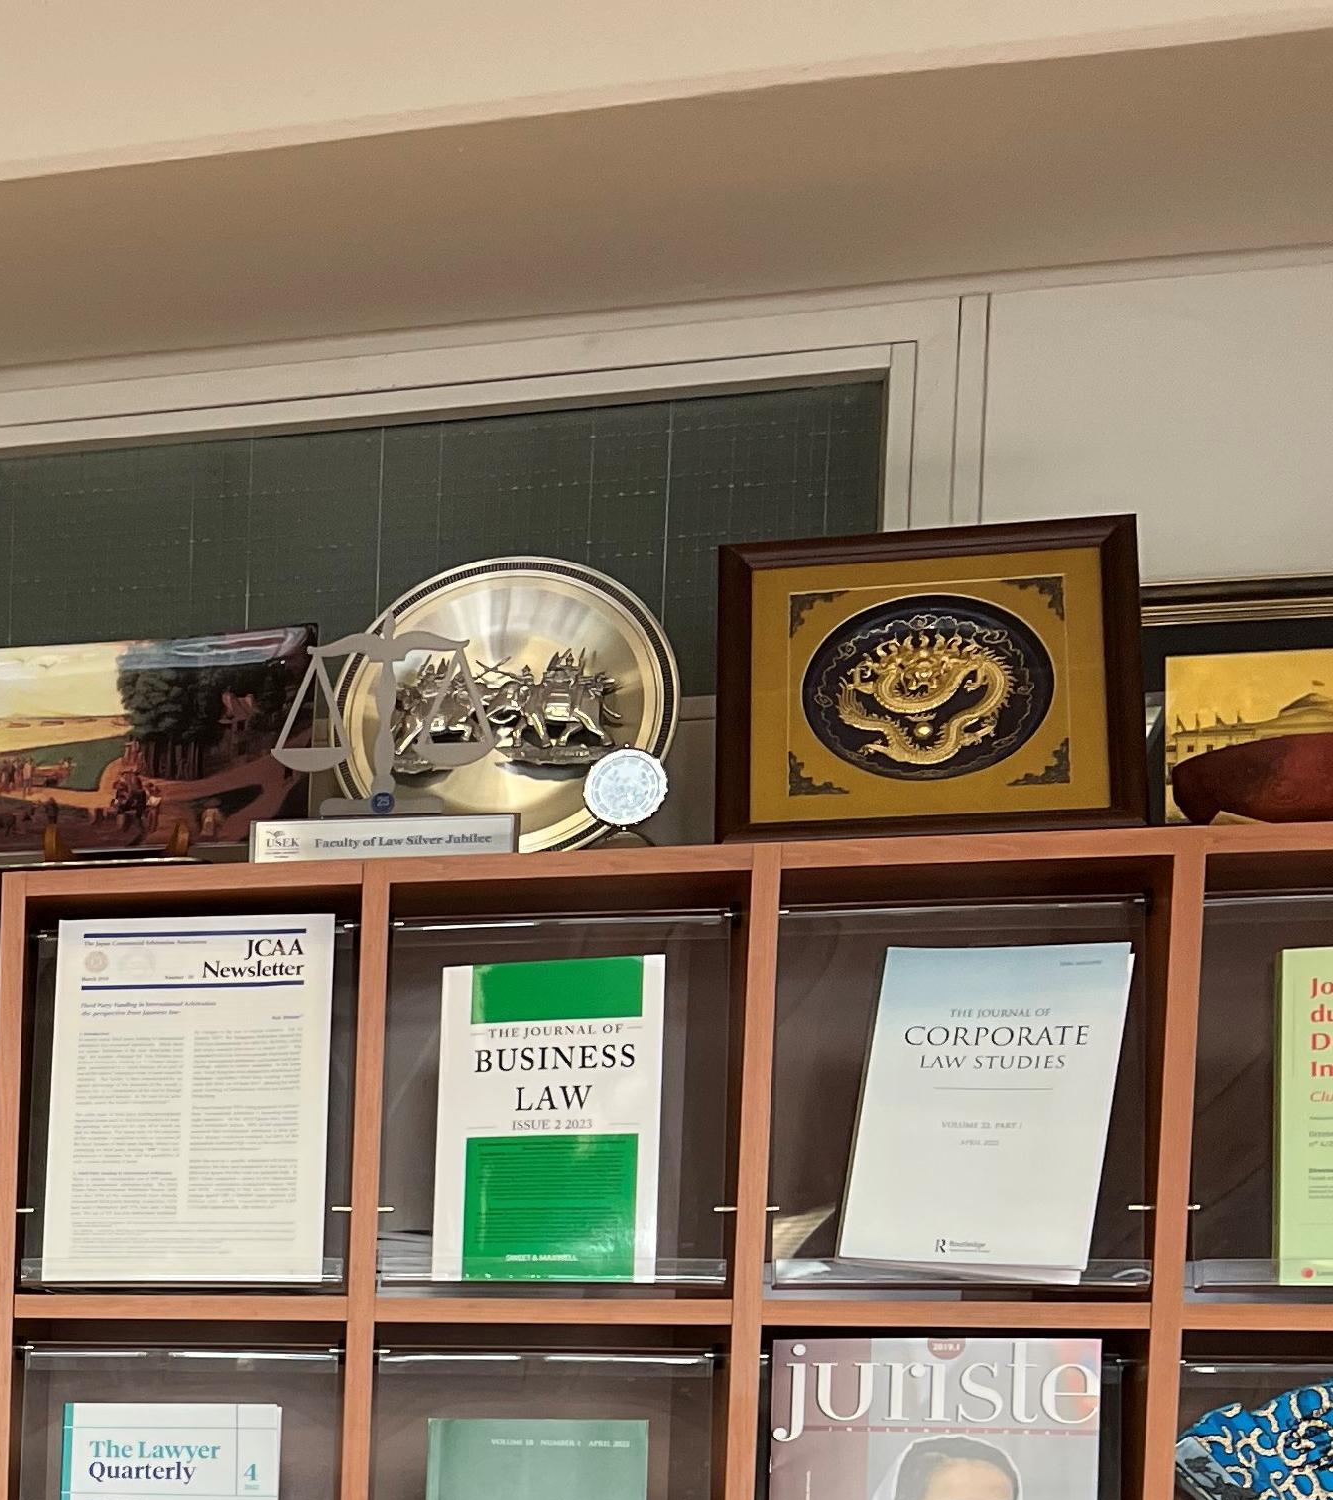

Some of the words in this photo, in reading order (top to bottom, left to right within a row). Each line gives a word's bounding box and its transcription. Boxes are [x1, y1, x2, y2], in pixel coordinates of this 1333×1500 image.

[315, 837, 359, 849] Faculty
[363, 837, 376, 847] of
[379, 836, 405, 847] Law
[406, 835, 444, 846] Silver
[445, 833, 493, 845] Jubilee
[244, 938, 304, 961] JCAA
[202, 960, 305, 979] Newsletter
[950, 1008, 974, 1018] THE
[977, 1007, 1032, 1019] JOURNAL
[1036, 1007, 1052, 1017] OF
[488, 1027, 519, 1039] THE
[523, 1024, 598, 1040] JOURNAL
[602, 1023, 625, 1035] OF
[904, 1023, 1091, 1047] CORPORATE
[474, 1043, 636, 1073] BUSINESS
[919, 1055, 967, 1069] LAW
[973, 1054, 1067, 1070] STUDIES
[515, 1084, 593, 1112] LAW
[512, 1119, 551, 1131] ISSUE
[554, 1119, 562, 1130] 2
[565, 1118, 593, 1130] 2023
[772, 1341, 1100, 1443] juriste
[89, 1439, 133, 1459] The
[137, 1440, 221, 1462] Lawyer
[88, 1461, 196, 1485] Quarterly
[244, 1462, 258, 1482] 4
